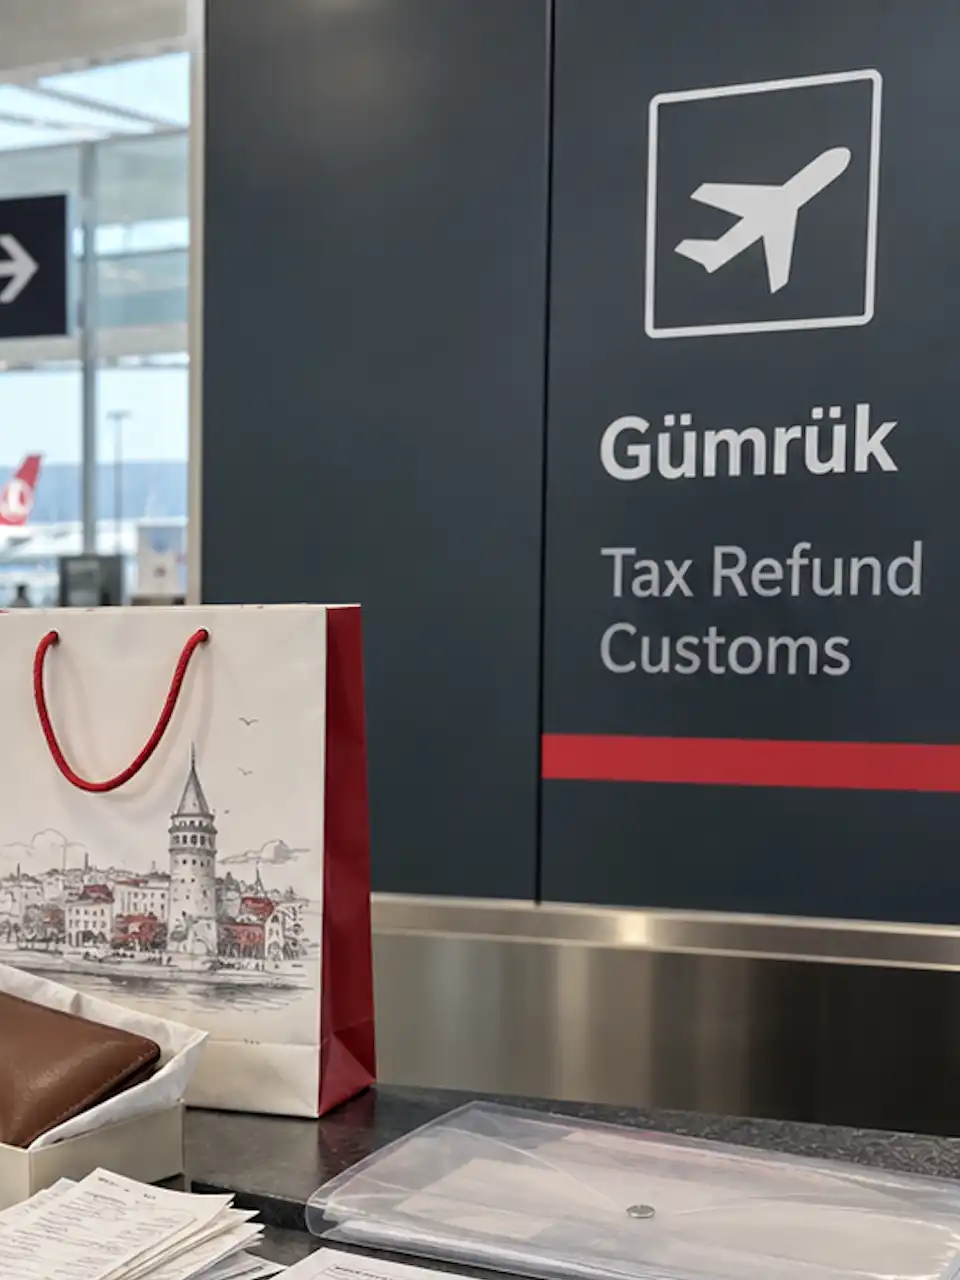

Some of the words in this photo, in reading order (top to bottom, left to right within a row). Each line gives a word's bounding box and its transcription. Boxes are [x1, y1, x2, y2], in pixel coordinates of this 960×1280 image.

[600, 403, 899, 481] Gümrük
[600, 546, 694, 598] Tax
[712, 540, 923, 598] Refund
[600, 622, 852, 676] Customs
